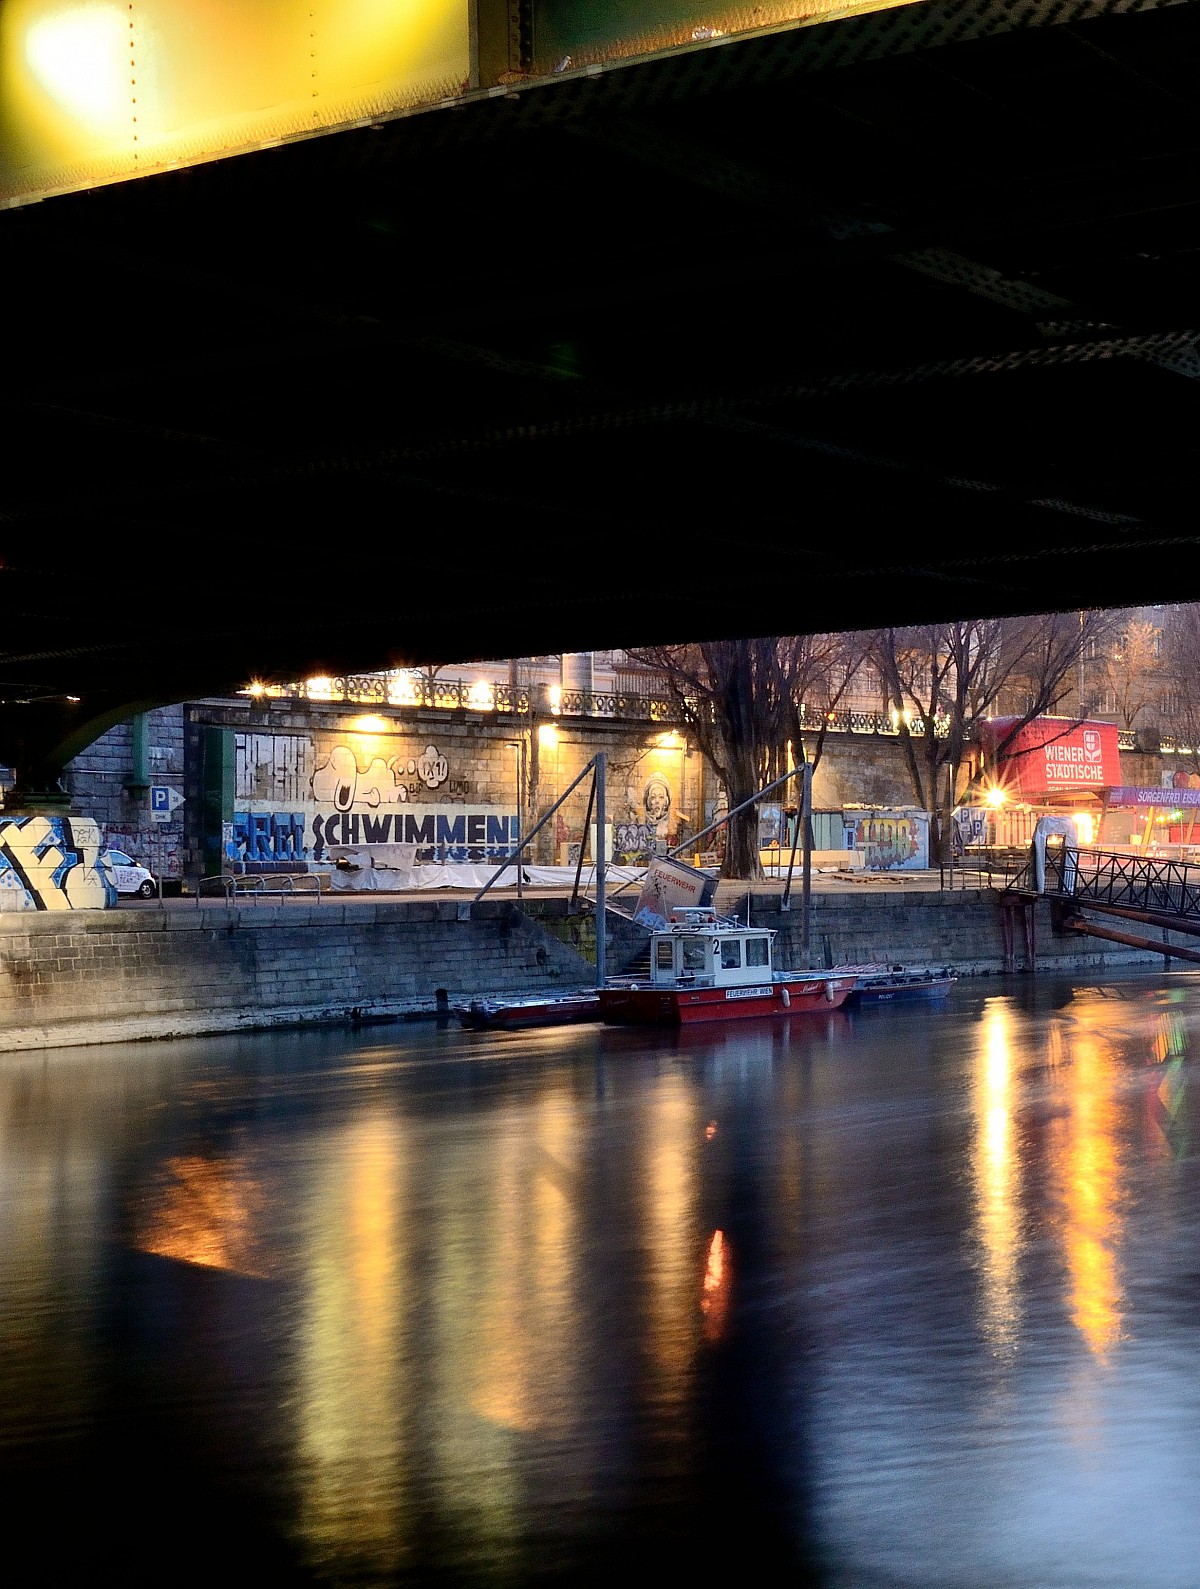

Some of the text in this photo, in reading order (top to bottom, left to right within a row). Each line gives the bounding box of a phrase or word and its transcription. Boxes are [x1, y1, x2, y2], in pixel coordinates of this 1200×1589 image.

[1045, 745, 1084, 762] WIENER
[1046, 763, 1104, 780] STÄDTISCHE
[155, 790, 166, 808] P
[1137, 791, 1180, 803] SORGENFREI
[312, 812, 519, 850] SCHWIMMEN!
[975, 821, 981, 835] P
[654, 869, 696, 893] FEUERWEHR
[713, 938, 720, 954] 2
[726, 989, 758, 997] FEUERWEHR
